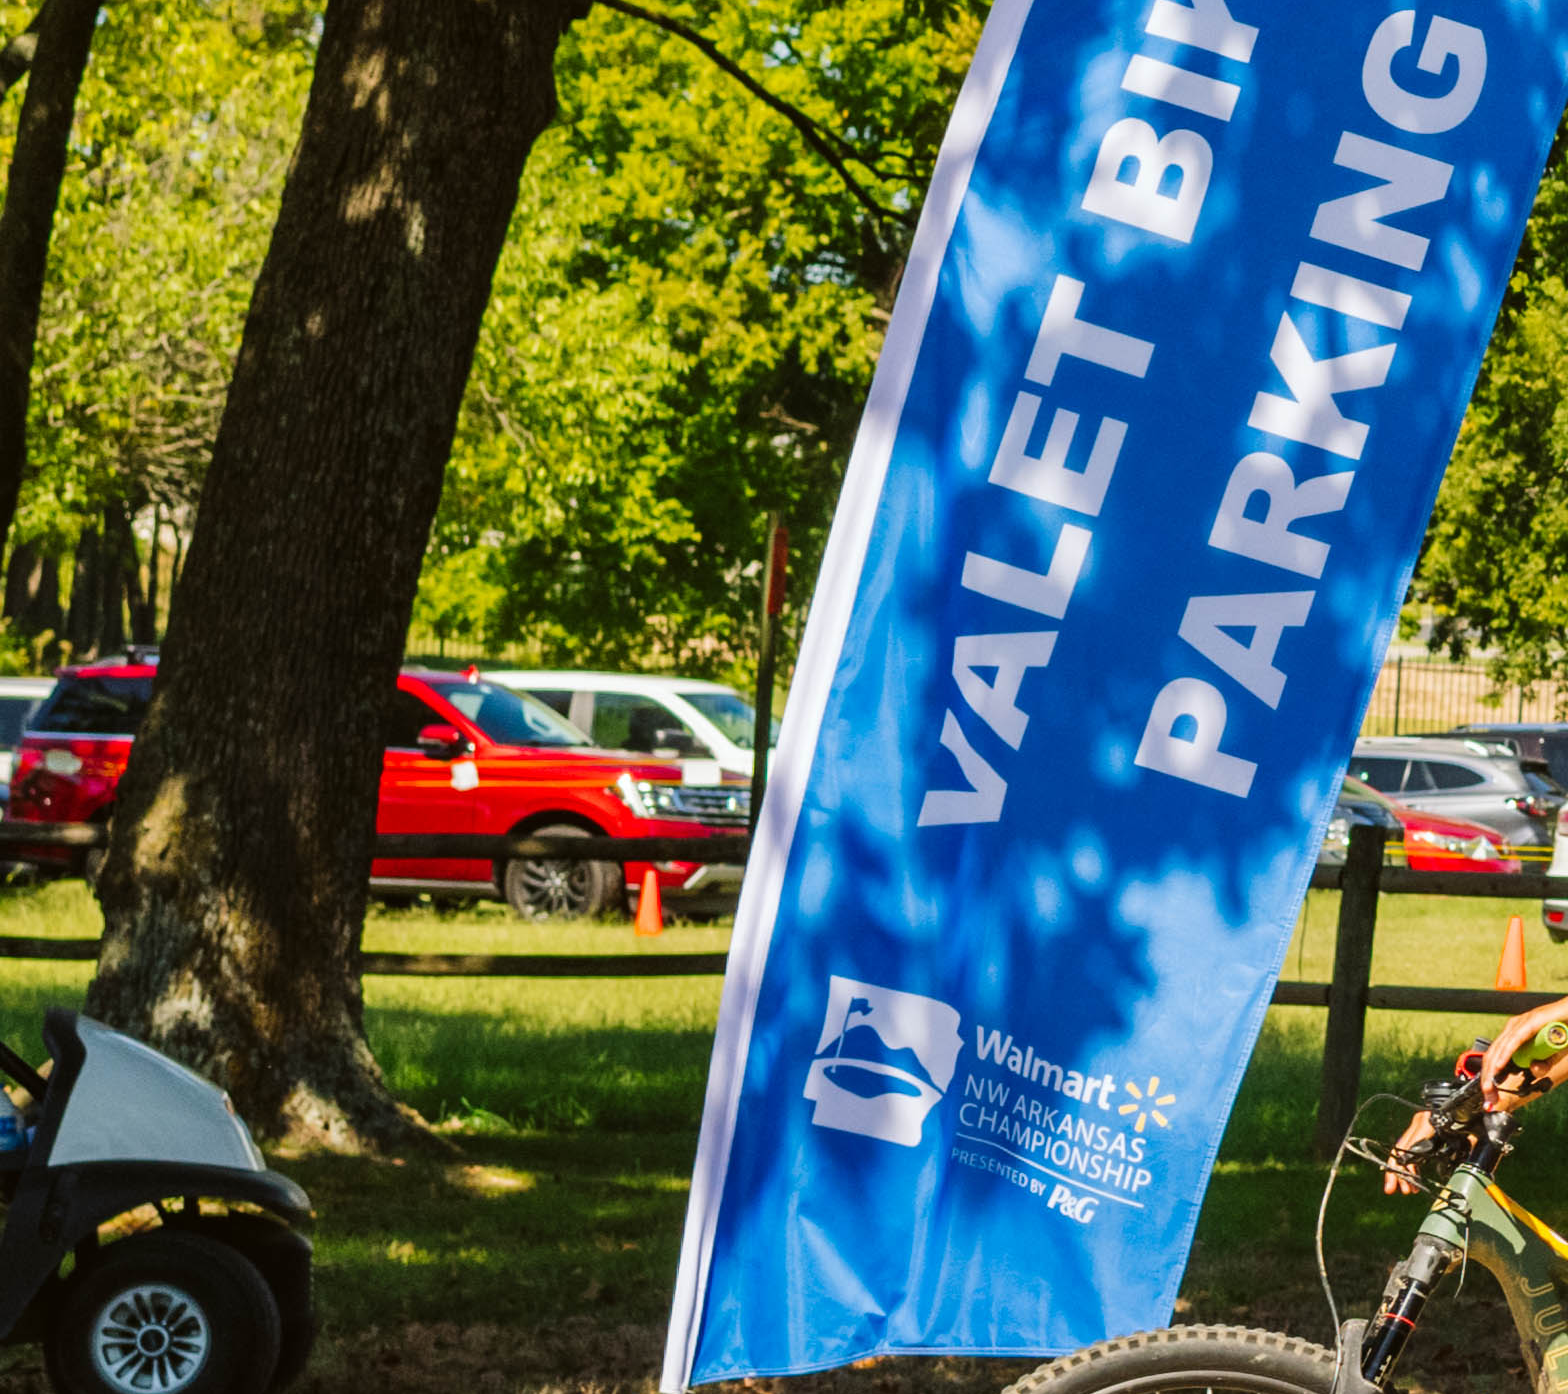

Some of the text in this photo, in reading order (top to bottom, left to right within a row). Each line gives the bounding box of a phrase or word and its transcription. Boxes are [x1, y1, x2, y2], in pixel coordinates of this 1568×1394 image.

[1134, 10, 1487, 799] PARKING
[916, 274, 1155, 828] VALET
[975, 1025, 1116, 1111] Walmart
[958, 1102, 1152, 1193] CHAMPIONSHIP
[964, 1074, 1147, 1164] NW ARKANSAS
[951, 1147, 1099, 1224] PRESENTED BY P&G
